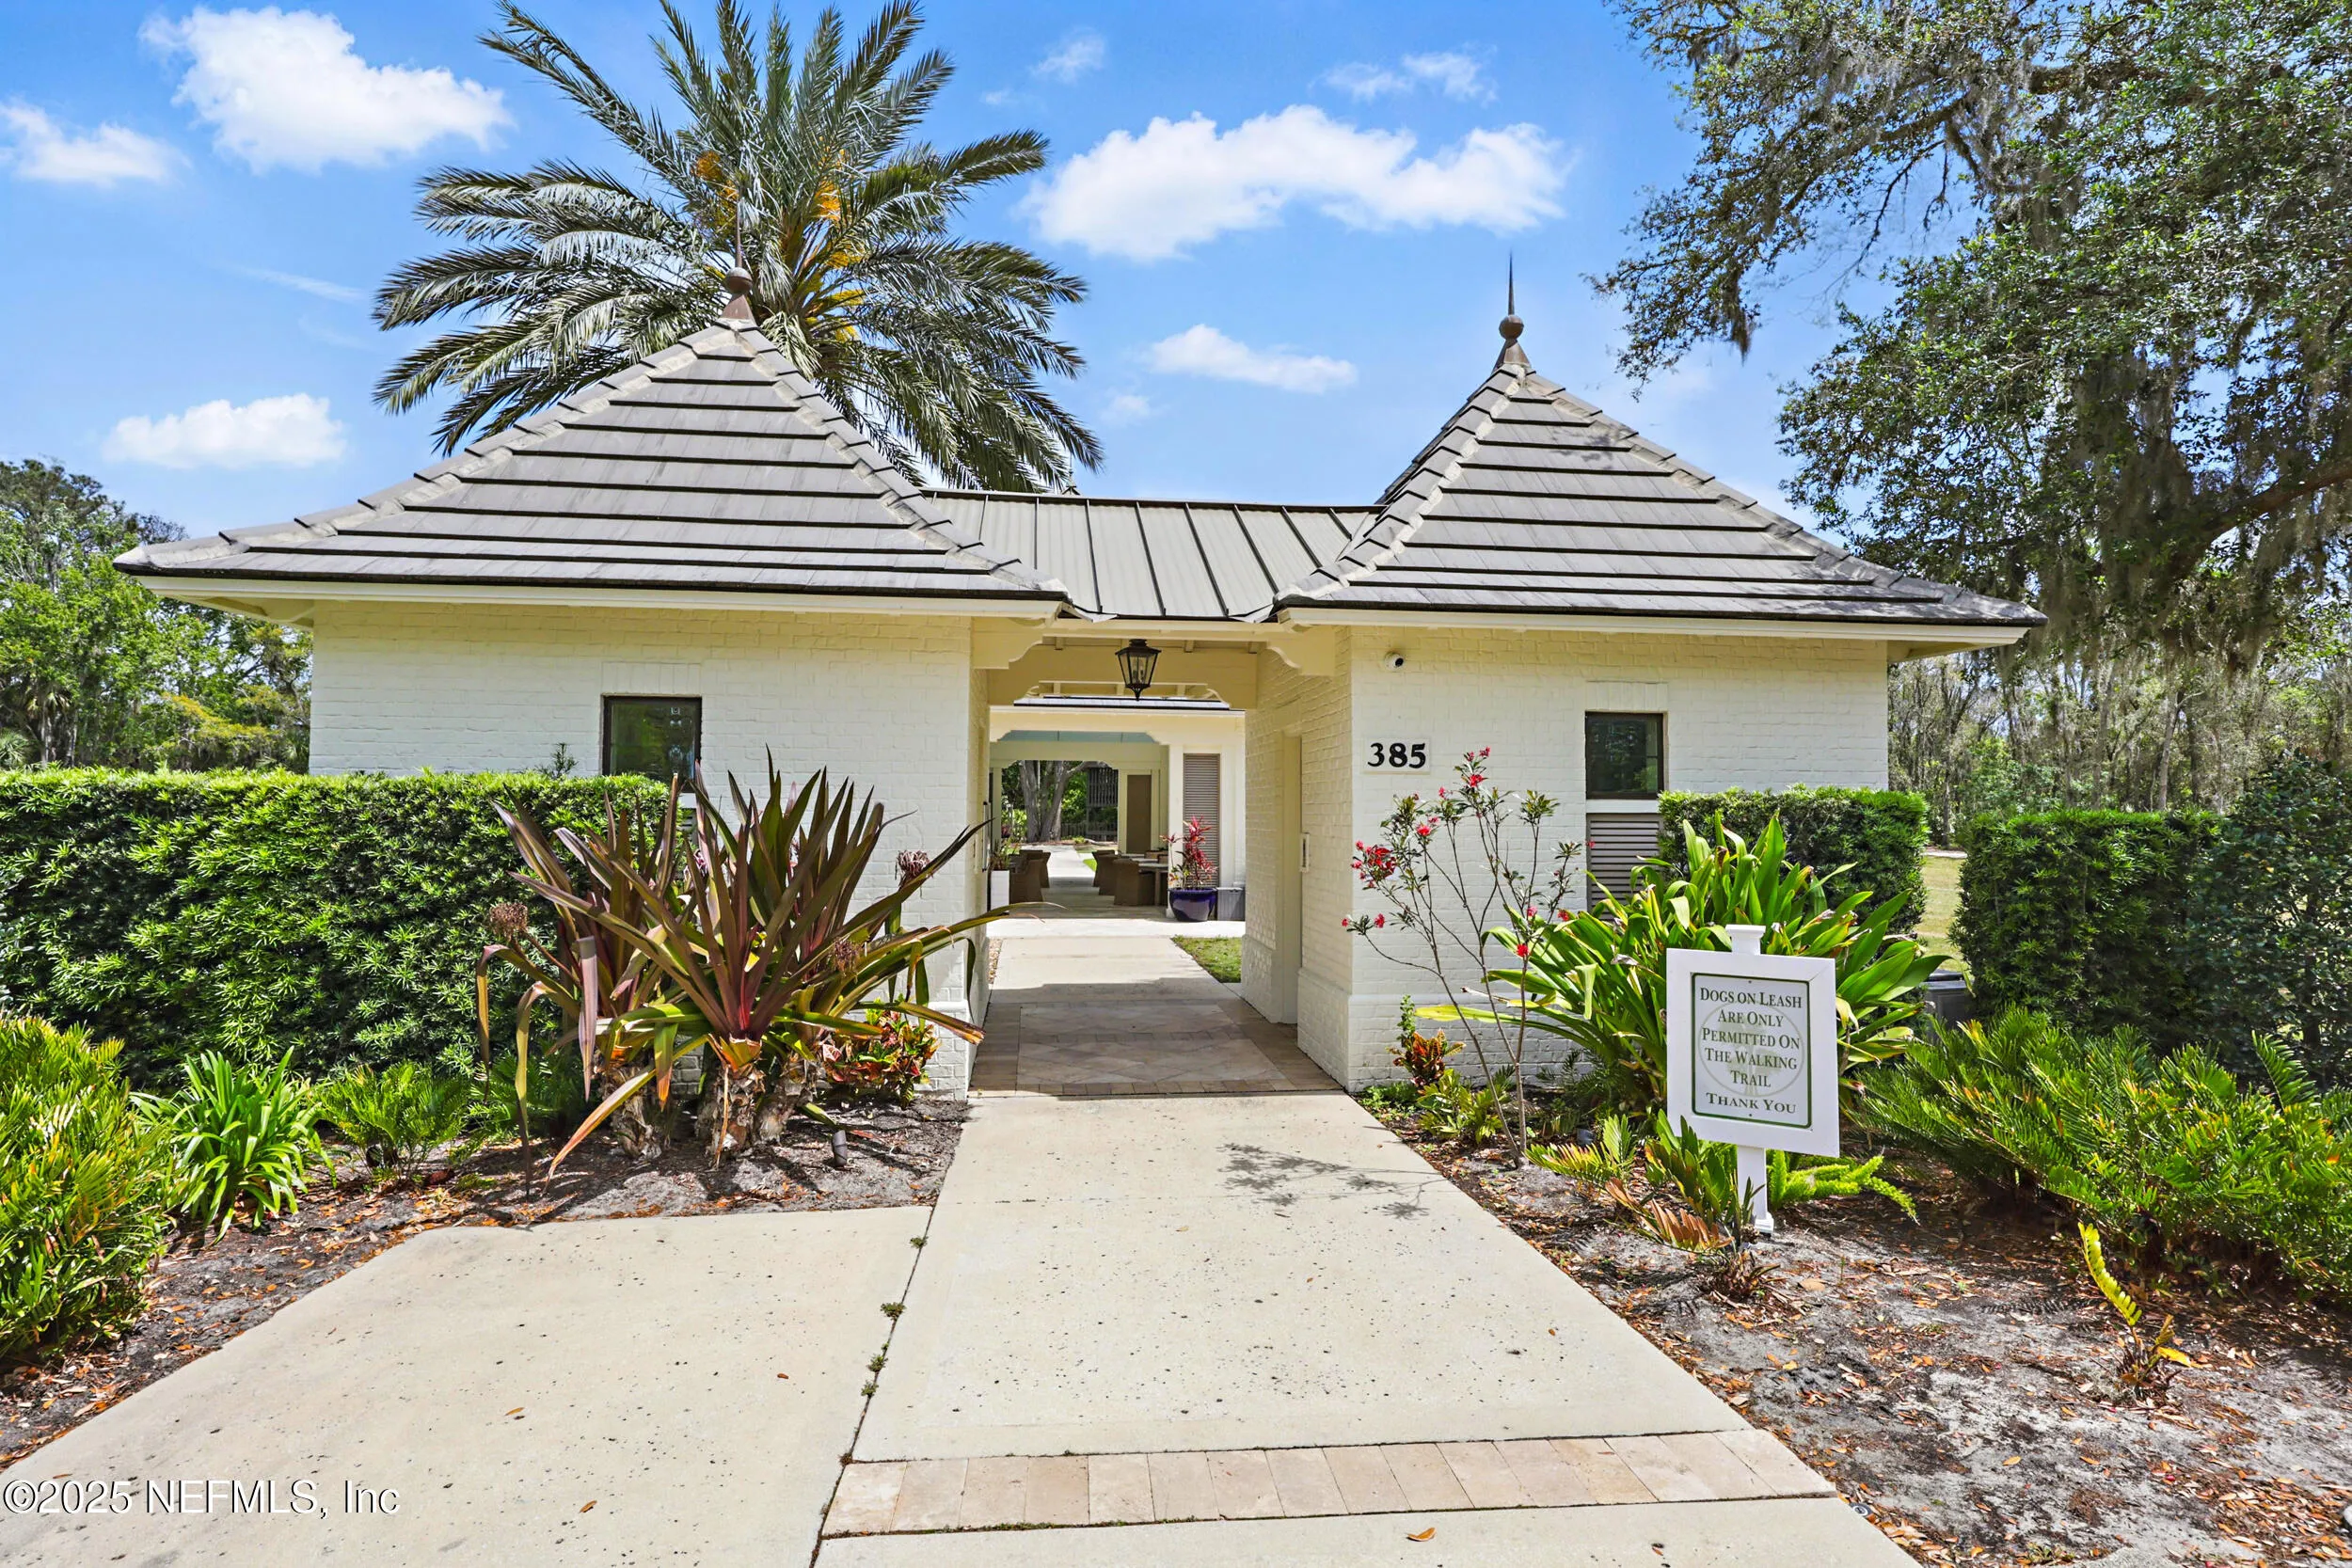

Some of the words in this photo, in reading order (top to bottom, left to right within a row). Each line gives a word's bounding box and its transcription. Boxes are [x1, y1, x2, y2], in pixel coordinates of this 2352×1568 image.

[1367, 742, 1426, 768] 385
[1700, 987, 1735, 1003] DOGS
[1738, 991, 1756, 1005] ON
[1759, 991, 1802, 1008] LEASH
[1718, 1009, 1744, 1024] ARE
[1747, 1011, 1784, 1027] ONLY
[1701, 1027, 1775, 1047] PERMITTED
[1779, 1034, 1800, 1050] ON
[1705, 1048, 1732, 1064] THE
[1735, 1051, 1798, 1069] WALKING
[1730, 1069, 1772, 1087] TRAIL
[1706, 1092, 1759, 1110] THANK
[1763, 1099, 1797, 1114] YOU
